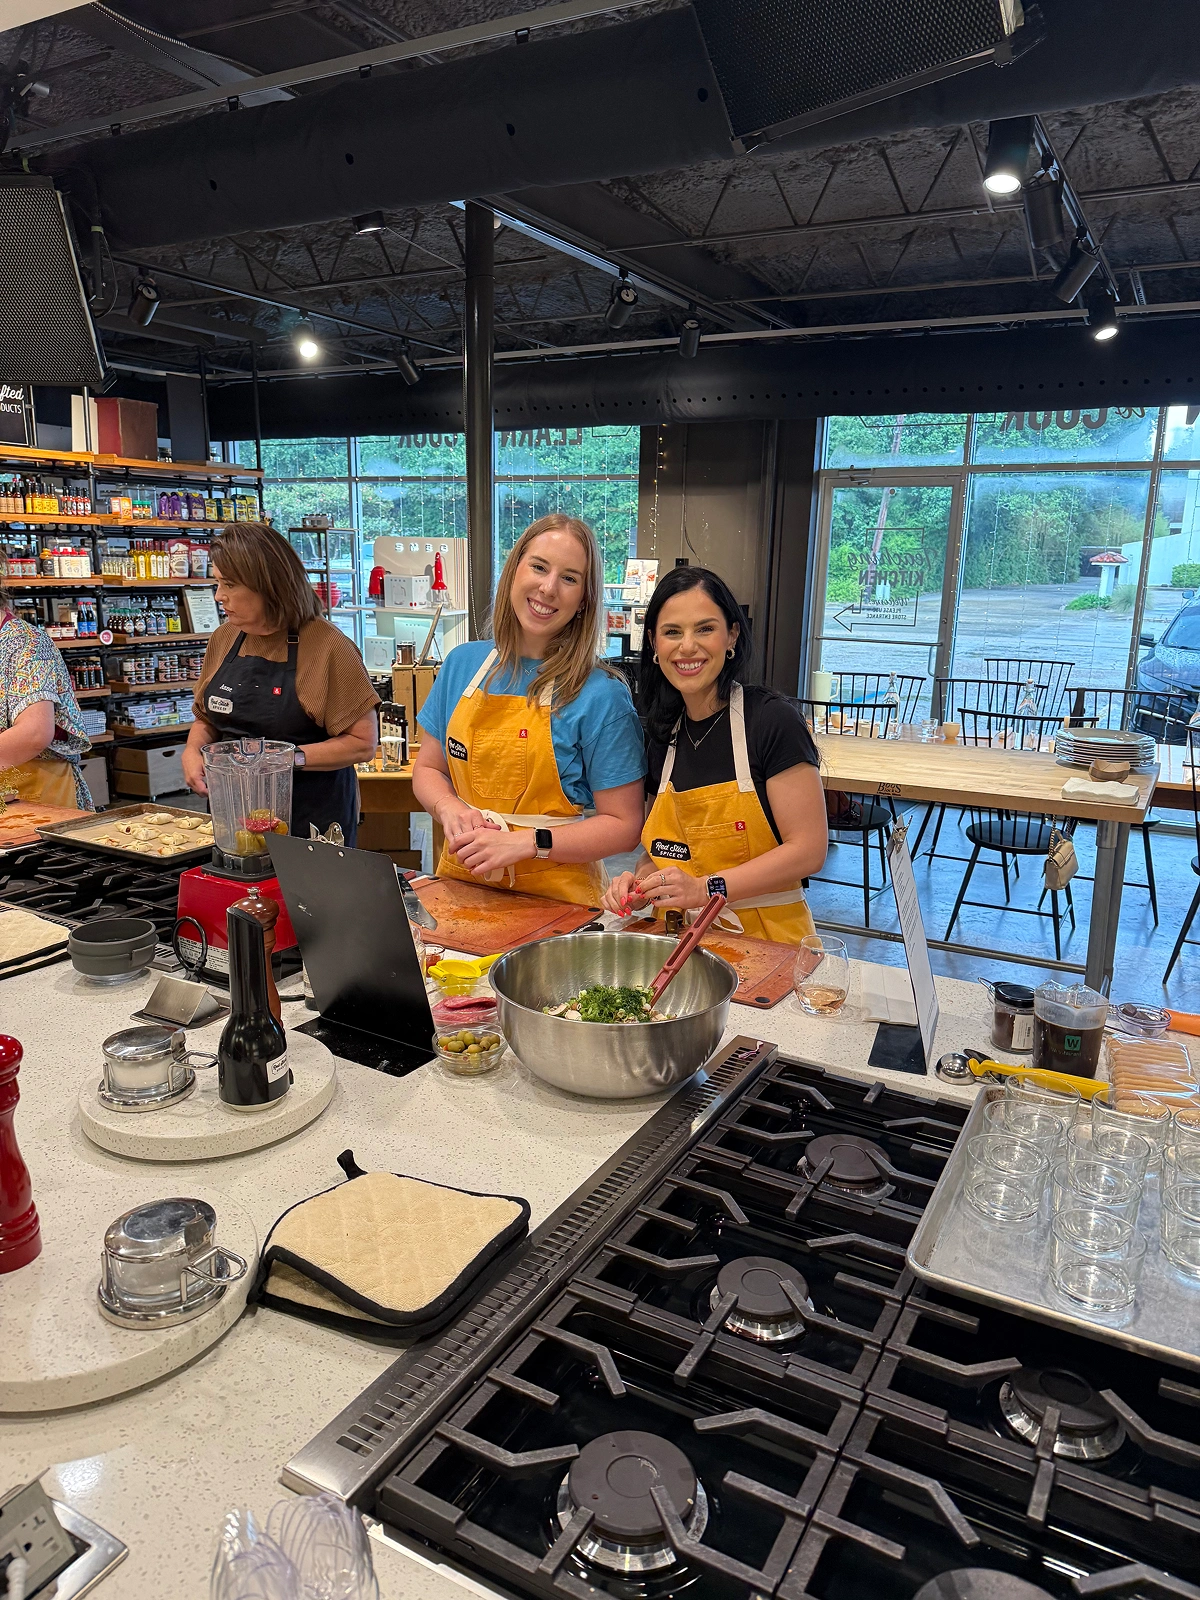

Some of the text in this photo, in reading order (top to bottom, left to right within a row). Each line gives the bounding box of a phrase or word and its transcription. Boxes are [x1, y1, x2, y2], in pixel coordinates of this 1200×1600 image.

[655, 841, 688, 854] Red Stick
[659, 850, 676, 858] SPICE
[1066, 1039, 1080, 1048] W
